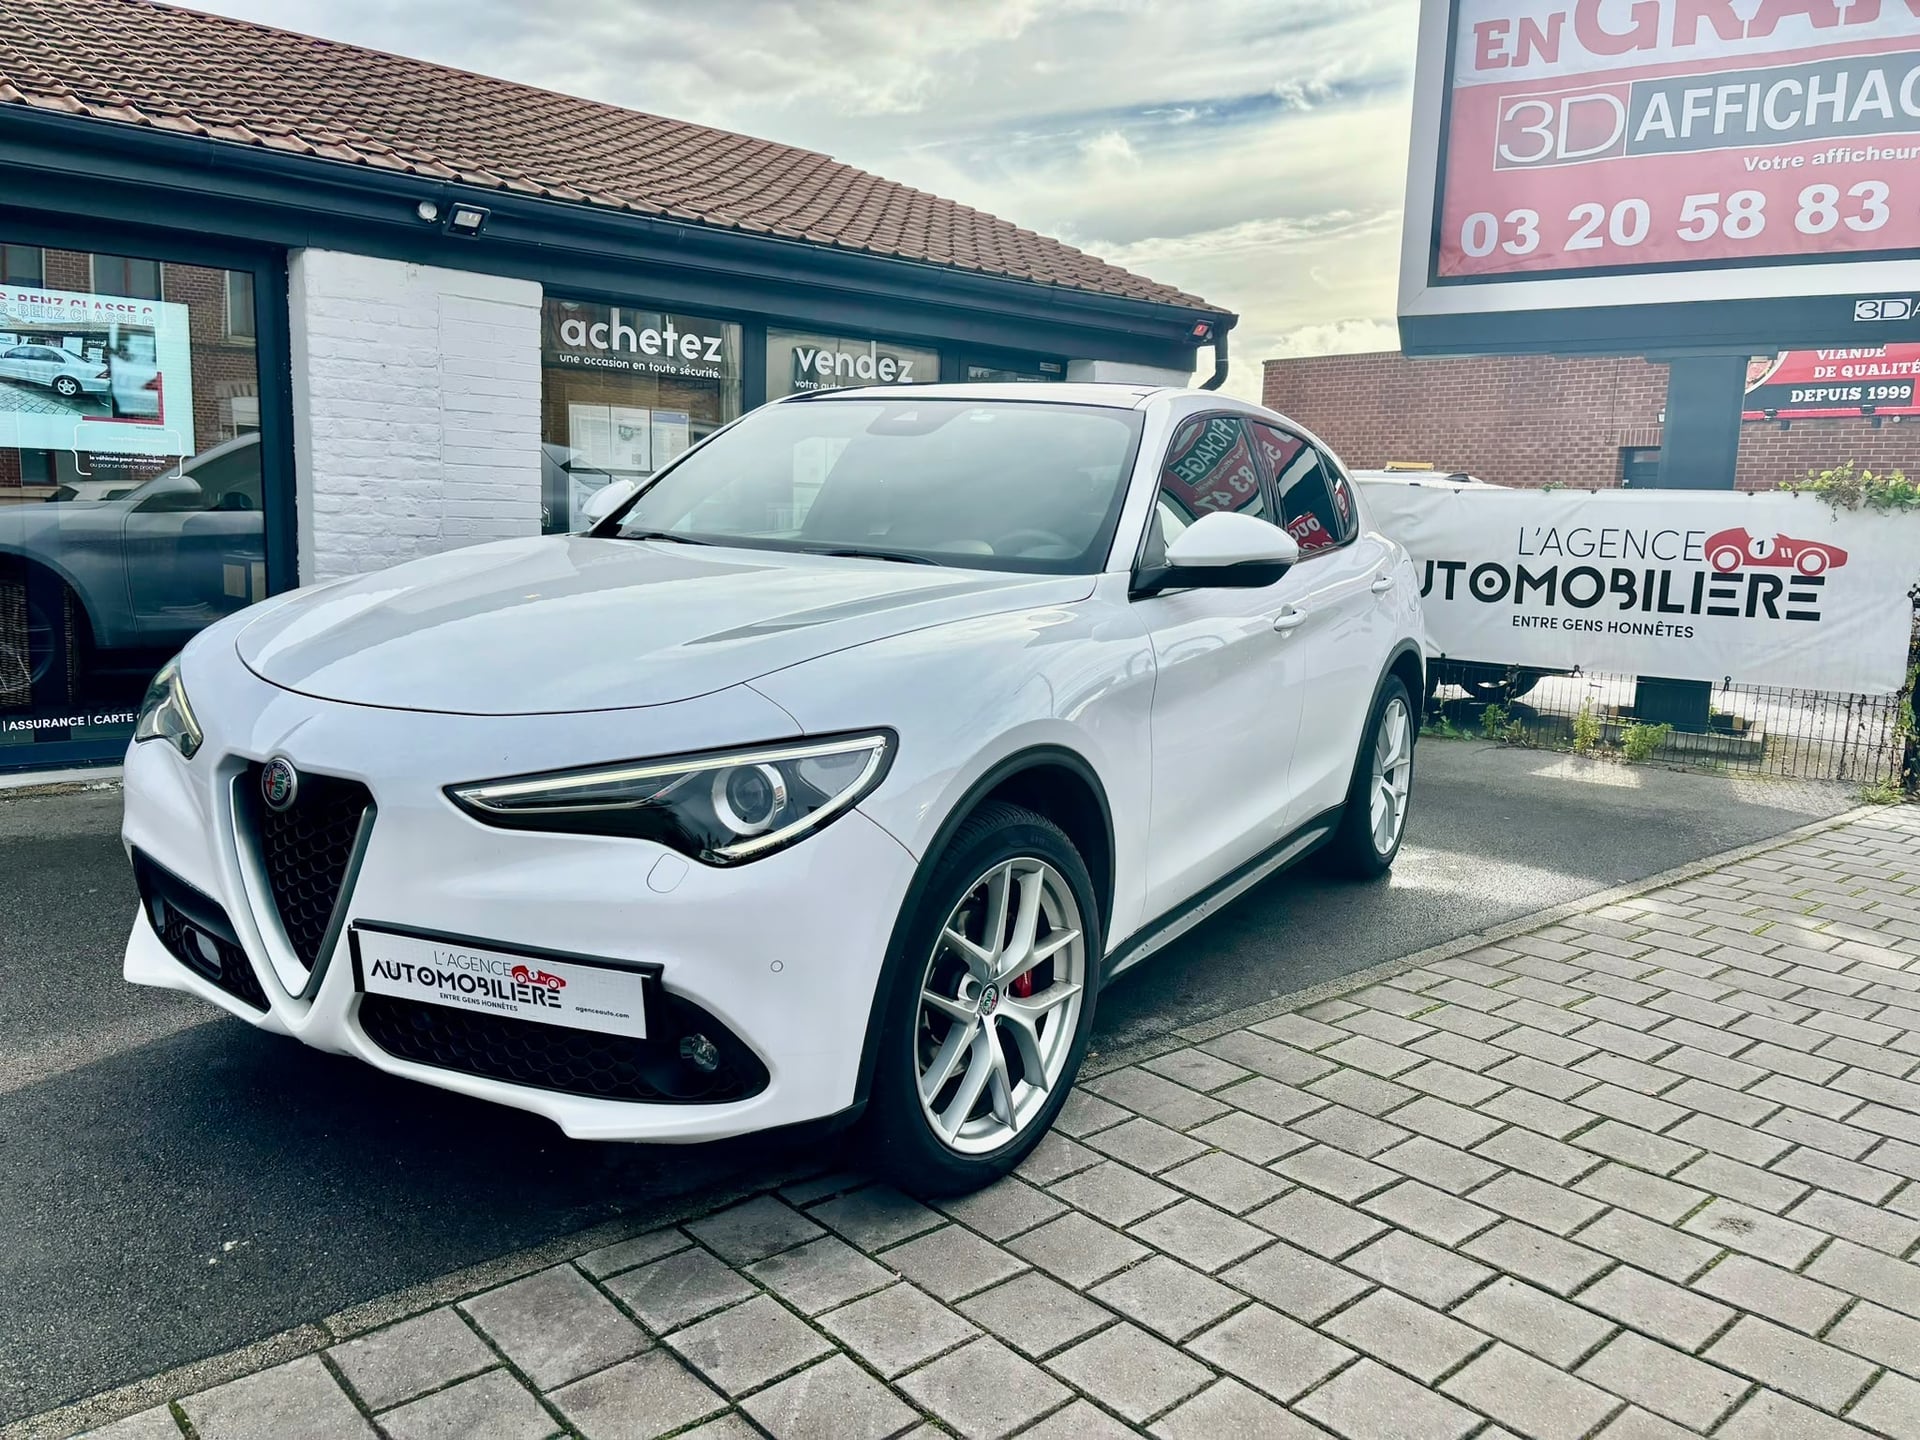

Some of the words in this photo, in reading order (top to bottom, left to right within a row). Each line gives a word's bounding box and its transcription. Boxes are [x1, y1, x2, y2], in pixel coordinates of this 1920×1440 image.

[1473, 12, 1566, 70] EN
[1499, 93, 1625, 163] 3D
[1743, 154, 1804, 172] Votre
[1812, 144, 1920, 166] afficheur
[1460, 208, 1541, 258] 03
[1563, 198, 1650, 252] 20
[1676, 189, 1767, 243] 58
[1794, 180, 1891, 235] 83
[1855, 300, 1910, 320] 3D
[560, 307, 723, 363] achetez
[559, 353, 580, 364] une
[583, 356, 630, 370] occasion
[632, 361, 646, 372] en
[648, 362, 677, 375] toute
[679, 364, 722, 380] sécurité.
[795, 340, 914, 383] vendez
[1816, 345, 1887, 361] VIANDE
[1813, 365, 1838, 379] DE
[1841, 358, 1920, 378] QUALITÉ
[794, 379, 819, 390] votre
[1790, 387, 1862, 403] DEPUIS
[1867, 386, 1912, 400] 1999
[1518, 526, 1706, 562] L'AGENCE
[1512, 615, 1558, 629] ENTRE
[1562, 618, 1603, 632] GENS
[1607, 621, 1694, 639] HONNÊTES
[8, 716, 85, 731] ASSURANCE
[93, 712, 134, 725] CARTE
[434, 950, 513, 978] L'AGENCE
[371, 959, 562, 1009] AUTOMOBILIERE
[439, 992, 461, 1002] ENTRE
[462, 997, 481, 1006] GENS
[575, 1005, 630, 1020] agenceauto.com
